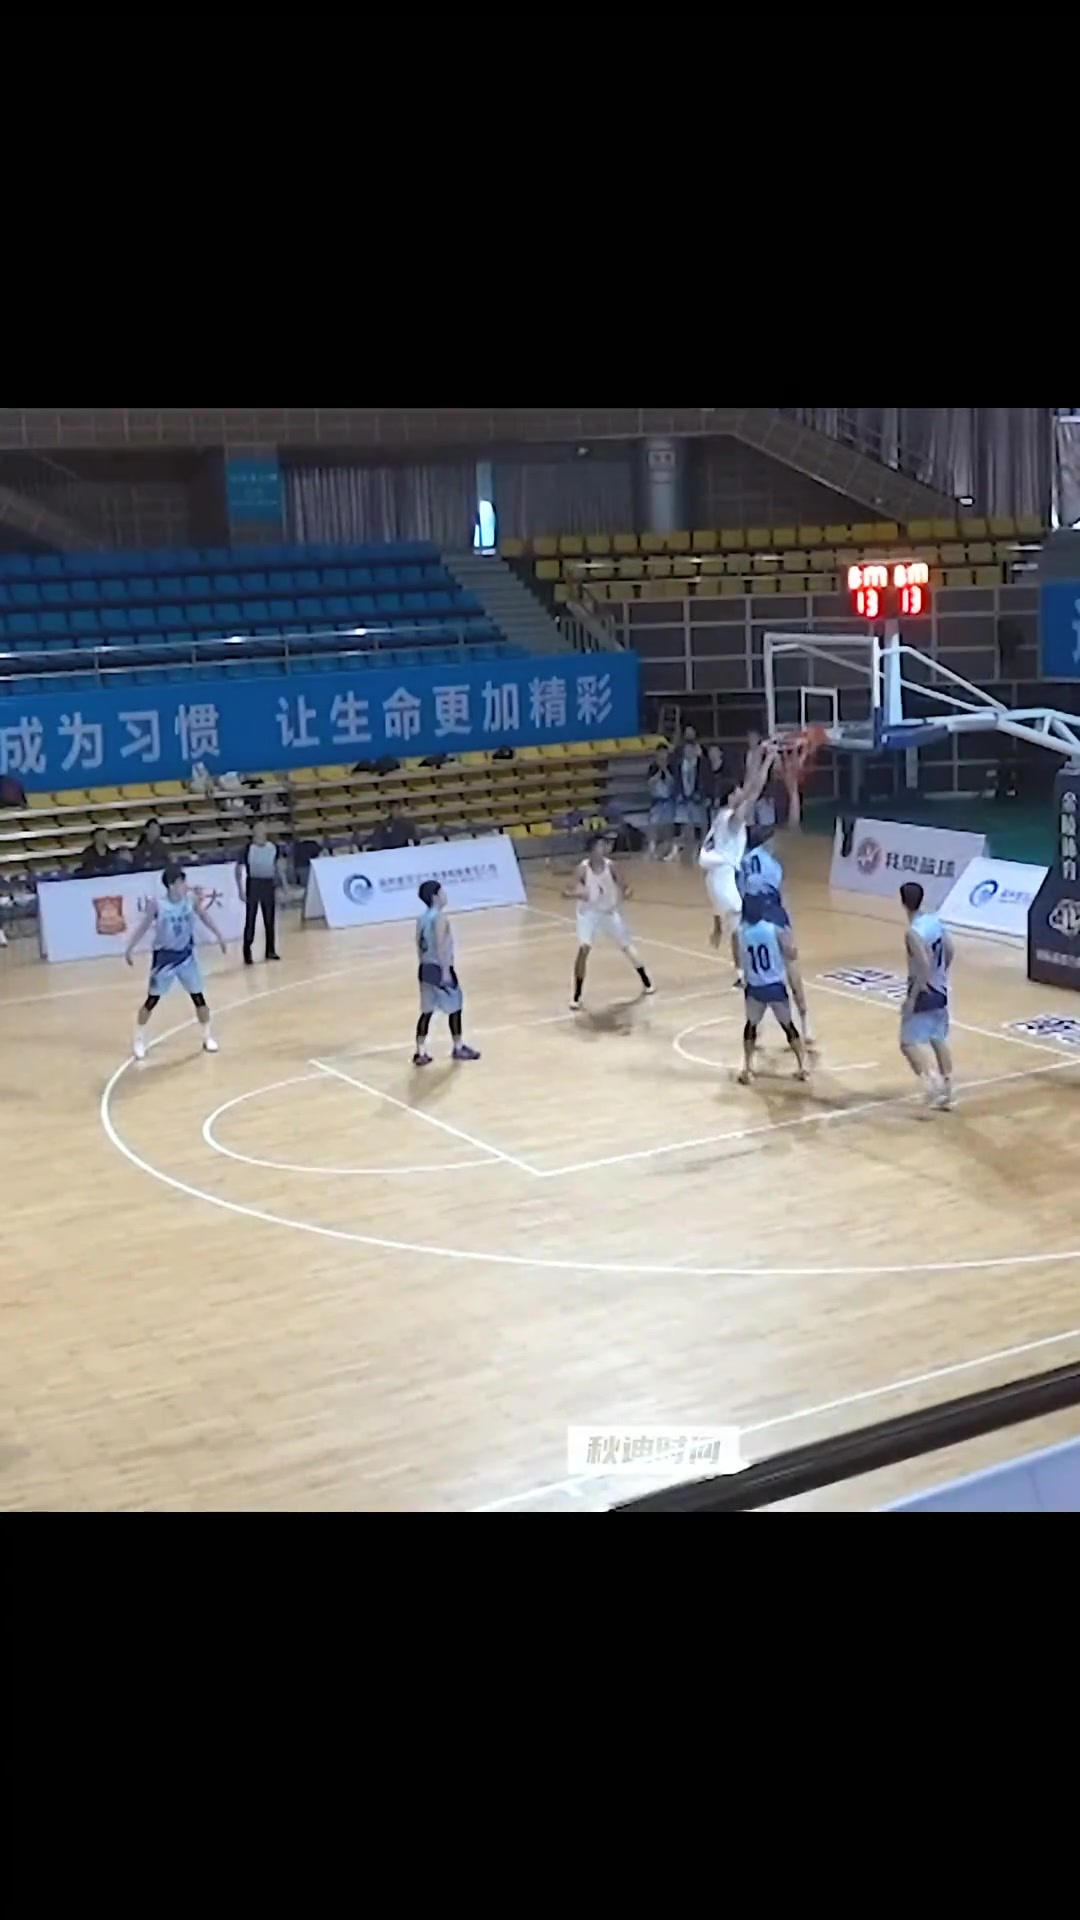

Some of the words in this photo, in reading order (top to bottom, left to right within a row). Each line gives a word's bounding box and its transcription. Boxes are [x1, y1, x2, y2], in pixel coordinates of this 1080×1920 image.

[0, 704, 221, 775] 成为习惯
[276, 673, 613, 748] 让生命更加精彩
[747, 943, 770, 974] 10
